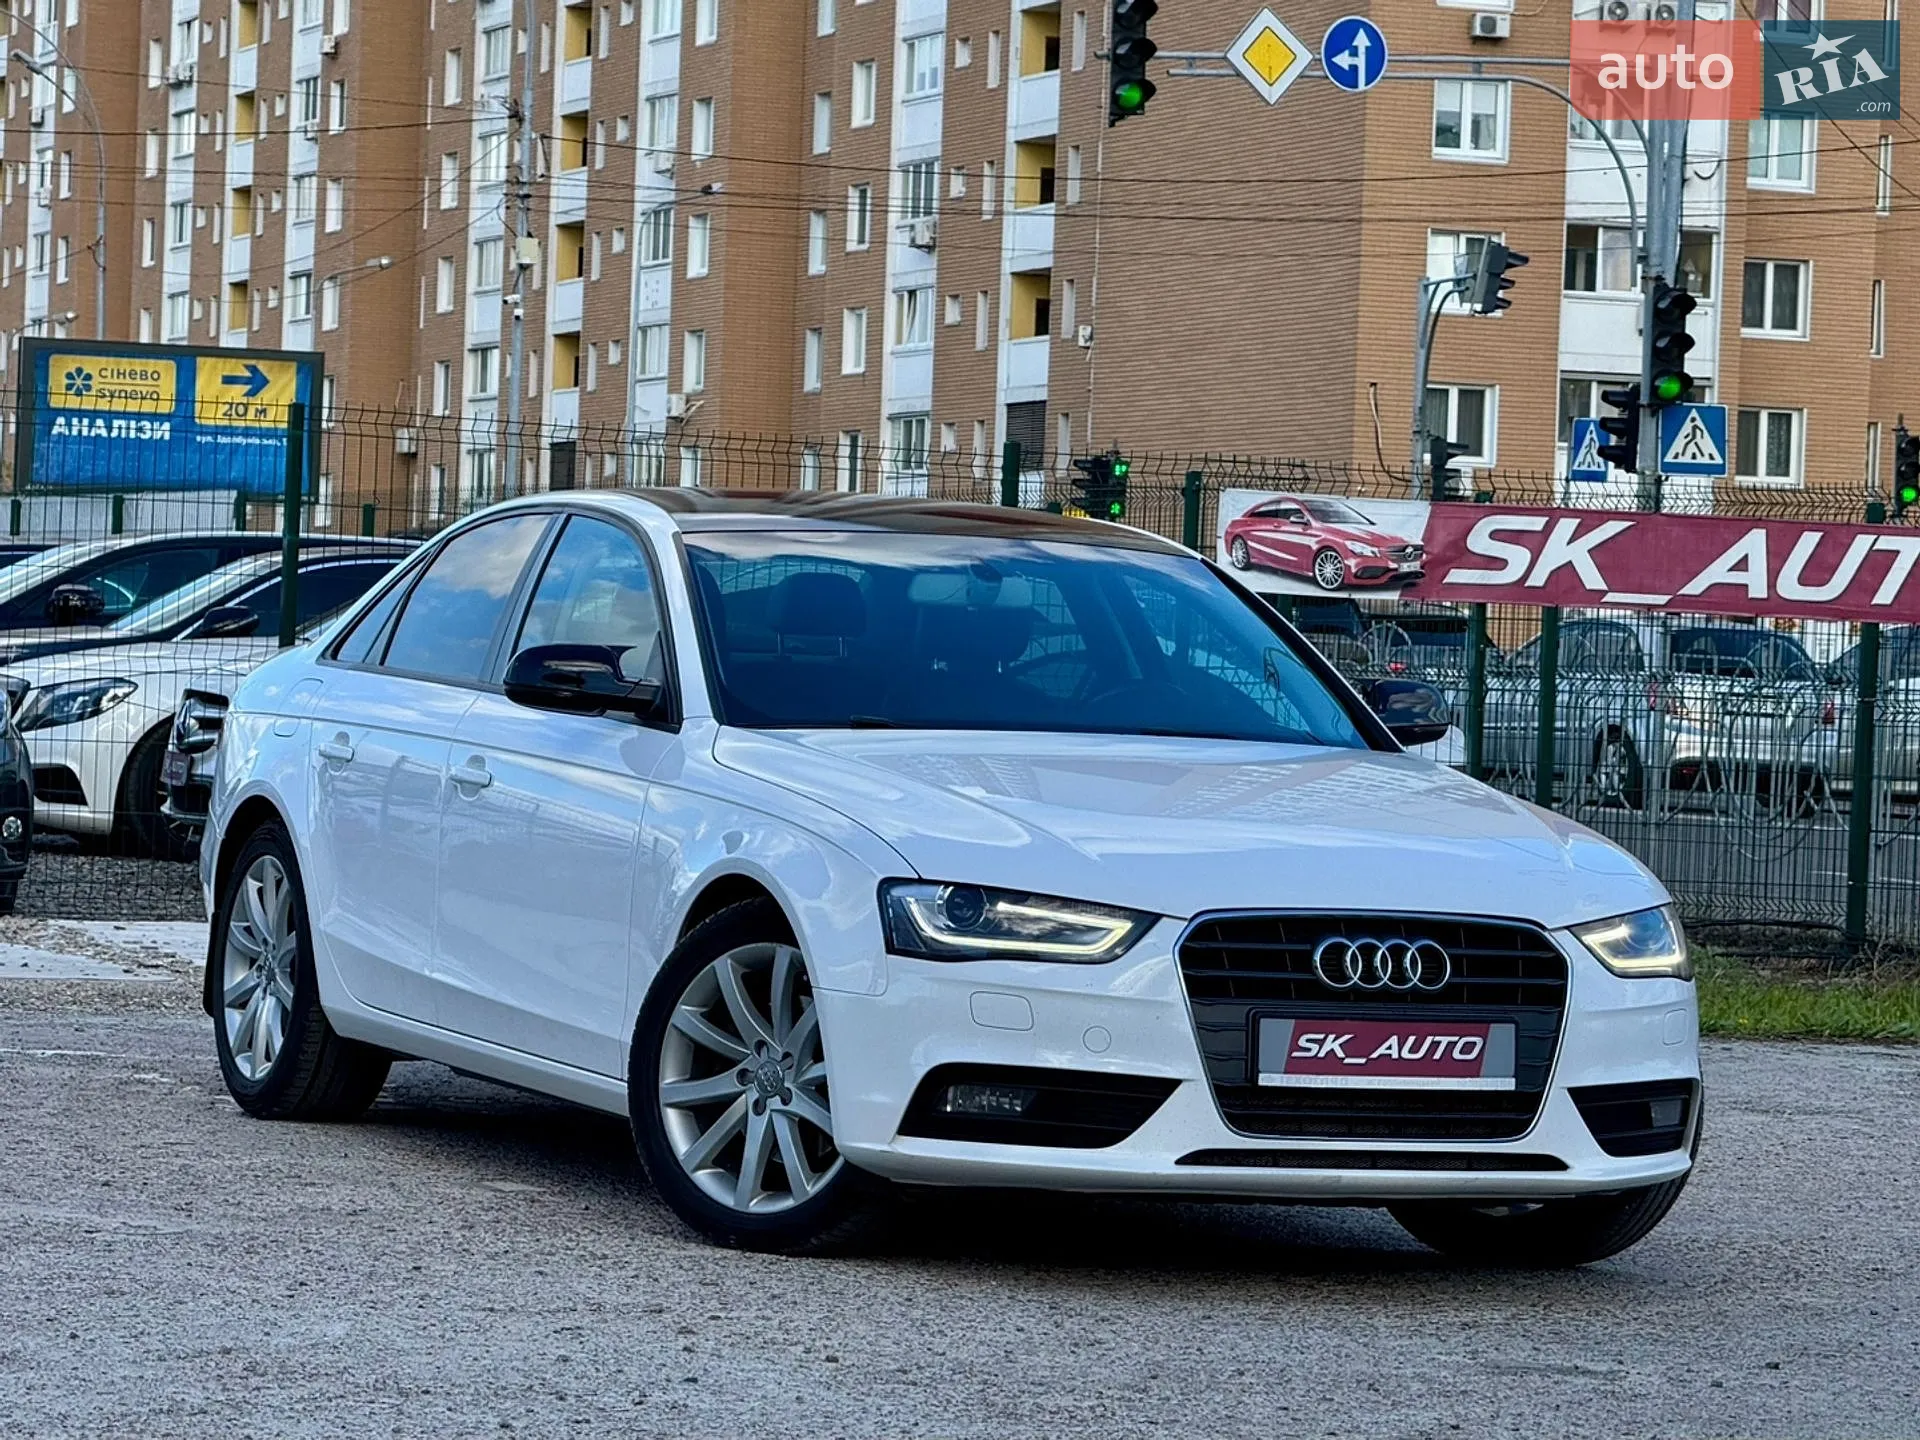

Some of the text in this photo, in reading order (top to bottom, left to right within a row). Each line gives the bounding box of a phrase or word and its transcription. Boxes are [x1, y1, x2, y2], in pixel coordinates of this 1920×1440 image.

[98, 387, 161, 402] synevo
[222, 402, 249, 418] 20
[51, 416, 171, 441] АНАЛІЗИ
[1291, 1033, 1484, 1064] SK_AUTO
